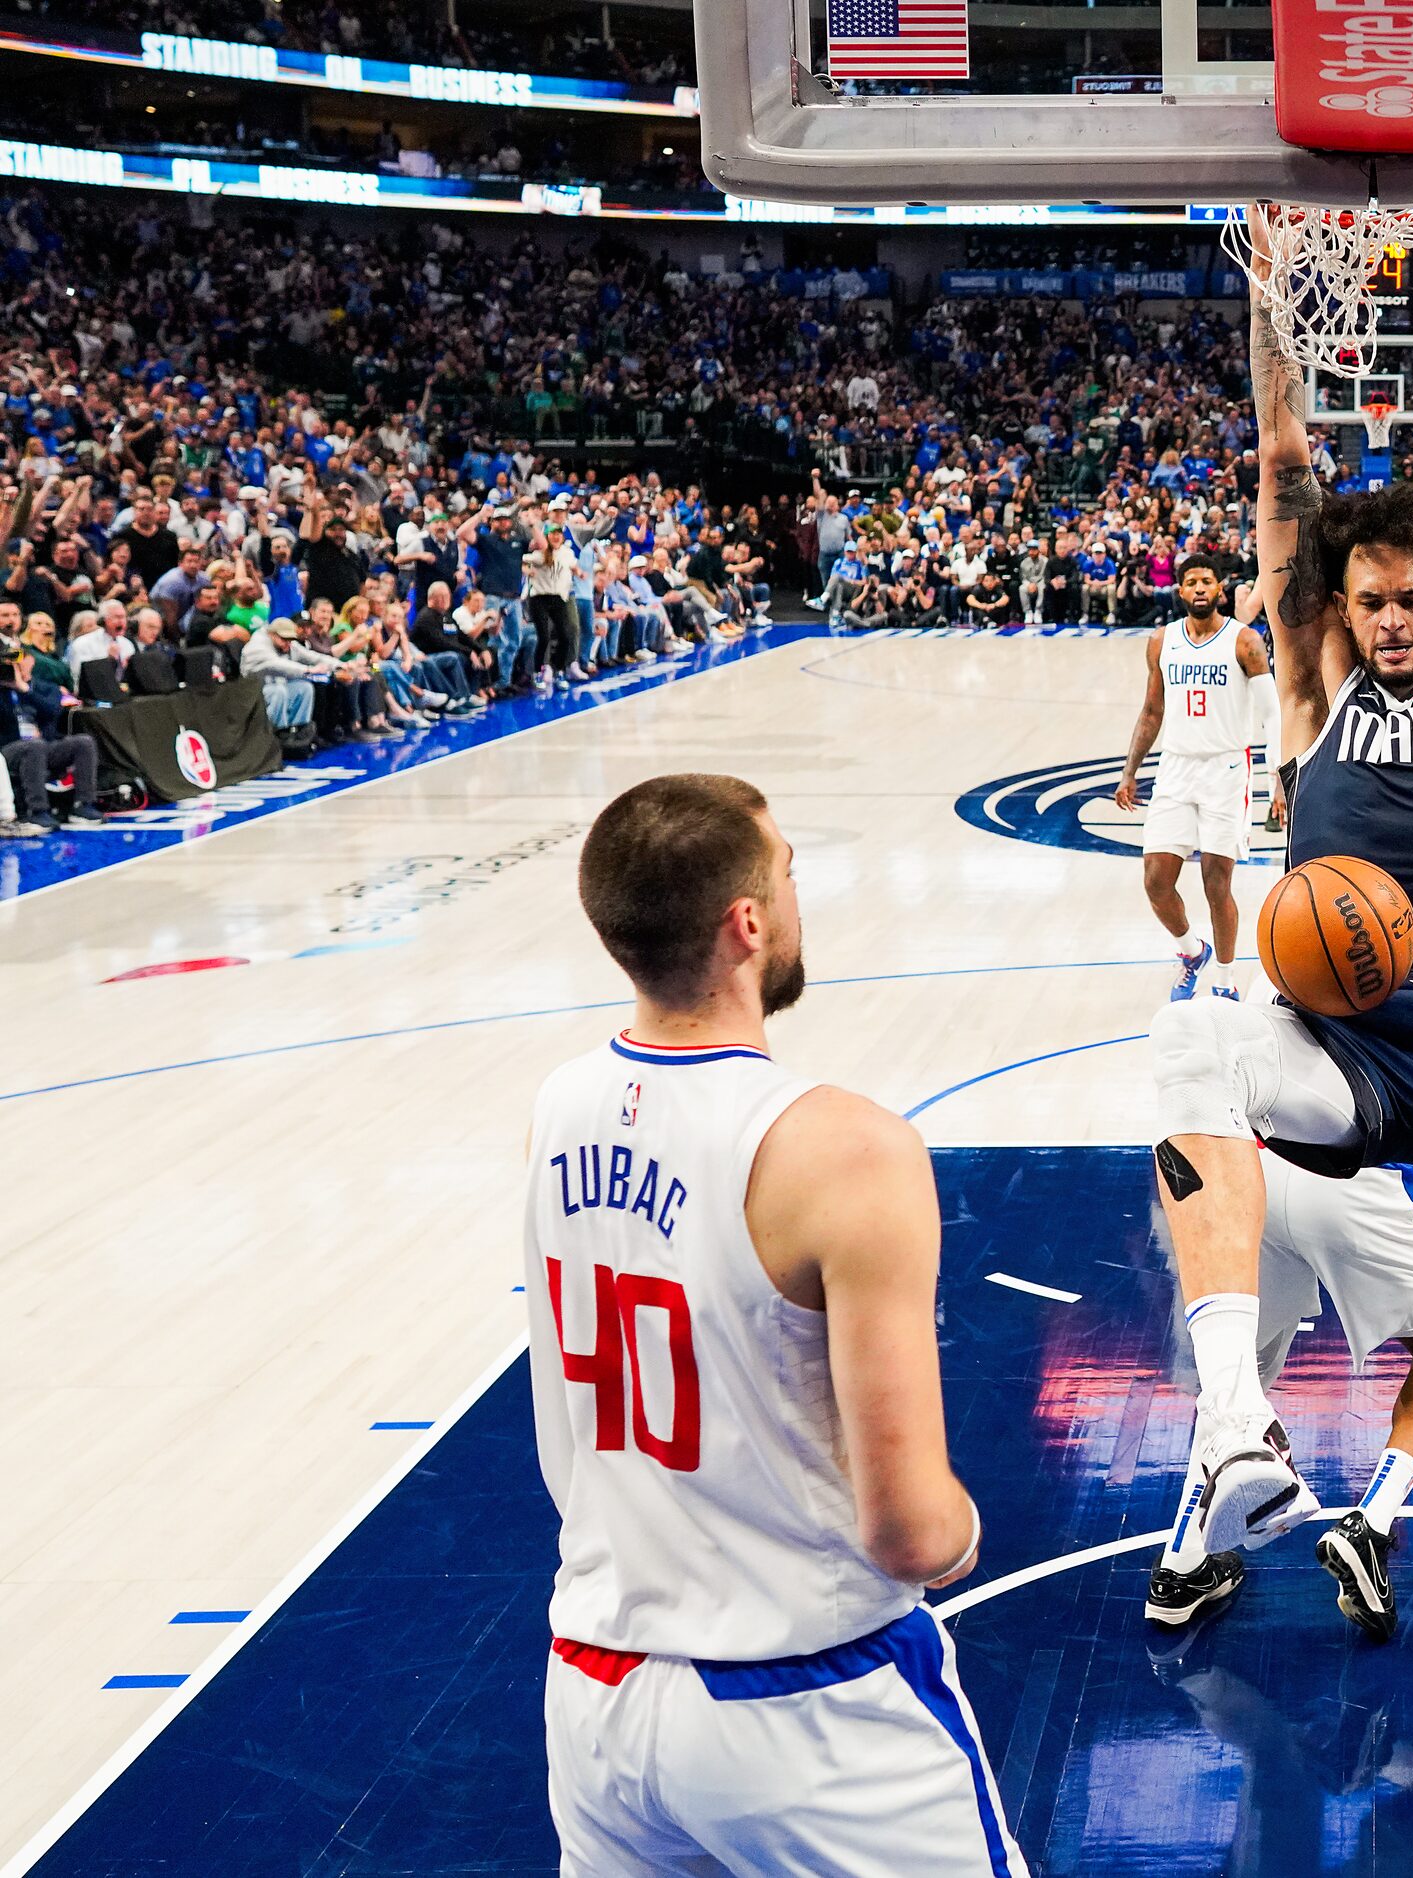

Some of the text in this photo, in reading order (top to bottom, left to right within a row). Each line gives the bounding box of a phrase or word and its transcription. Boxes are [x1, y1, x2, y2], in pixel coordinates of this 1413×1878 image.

[141, 32, 533, 106] STANDING ON BUSINESS
[1168, 663, 1228, 686] CLIPPERS
[1187, 689, 1206, 717] 13
[1332, 892, 1384, 999] Wilson
[550, 1143, 688, 1240] ZUBAC
[545, 1255, 702, 1473] 40
